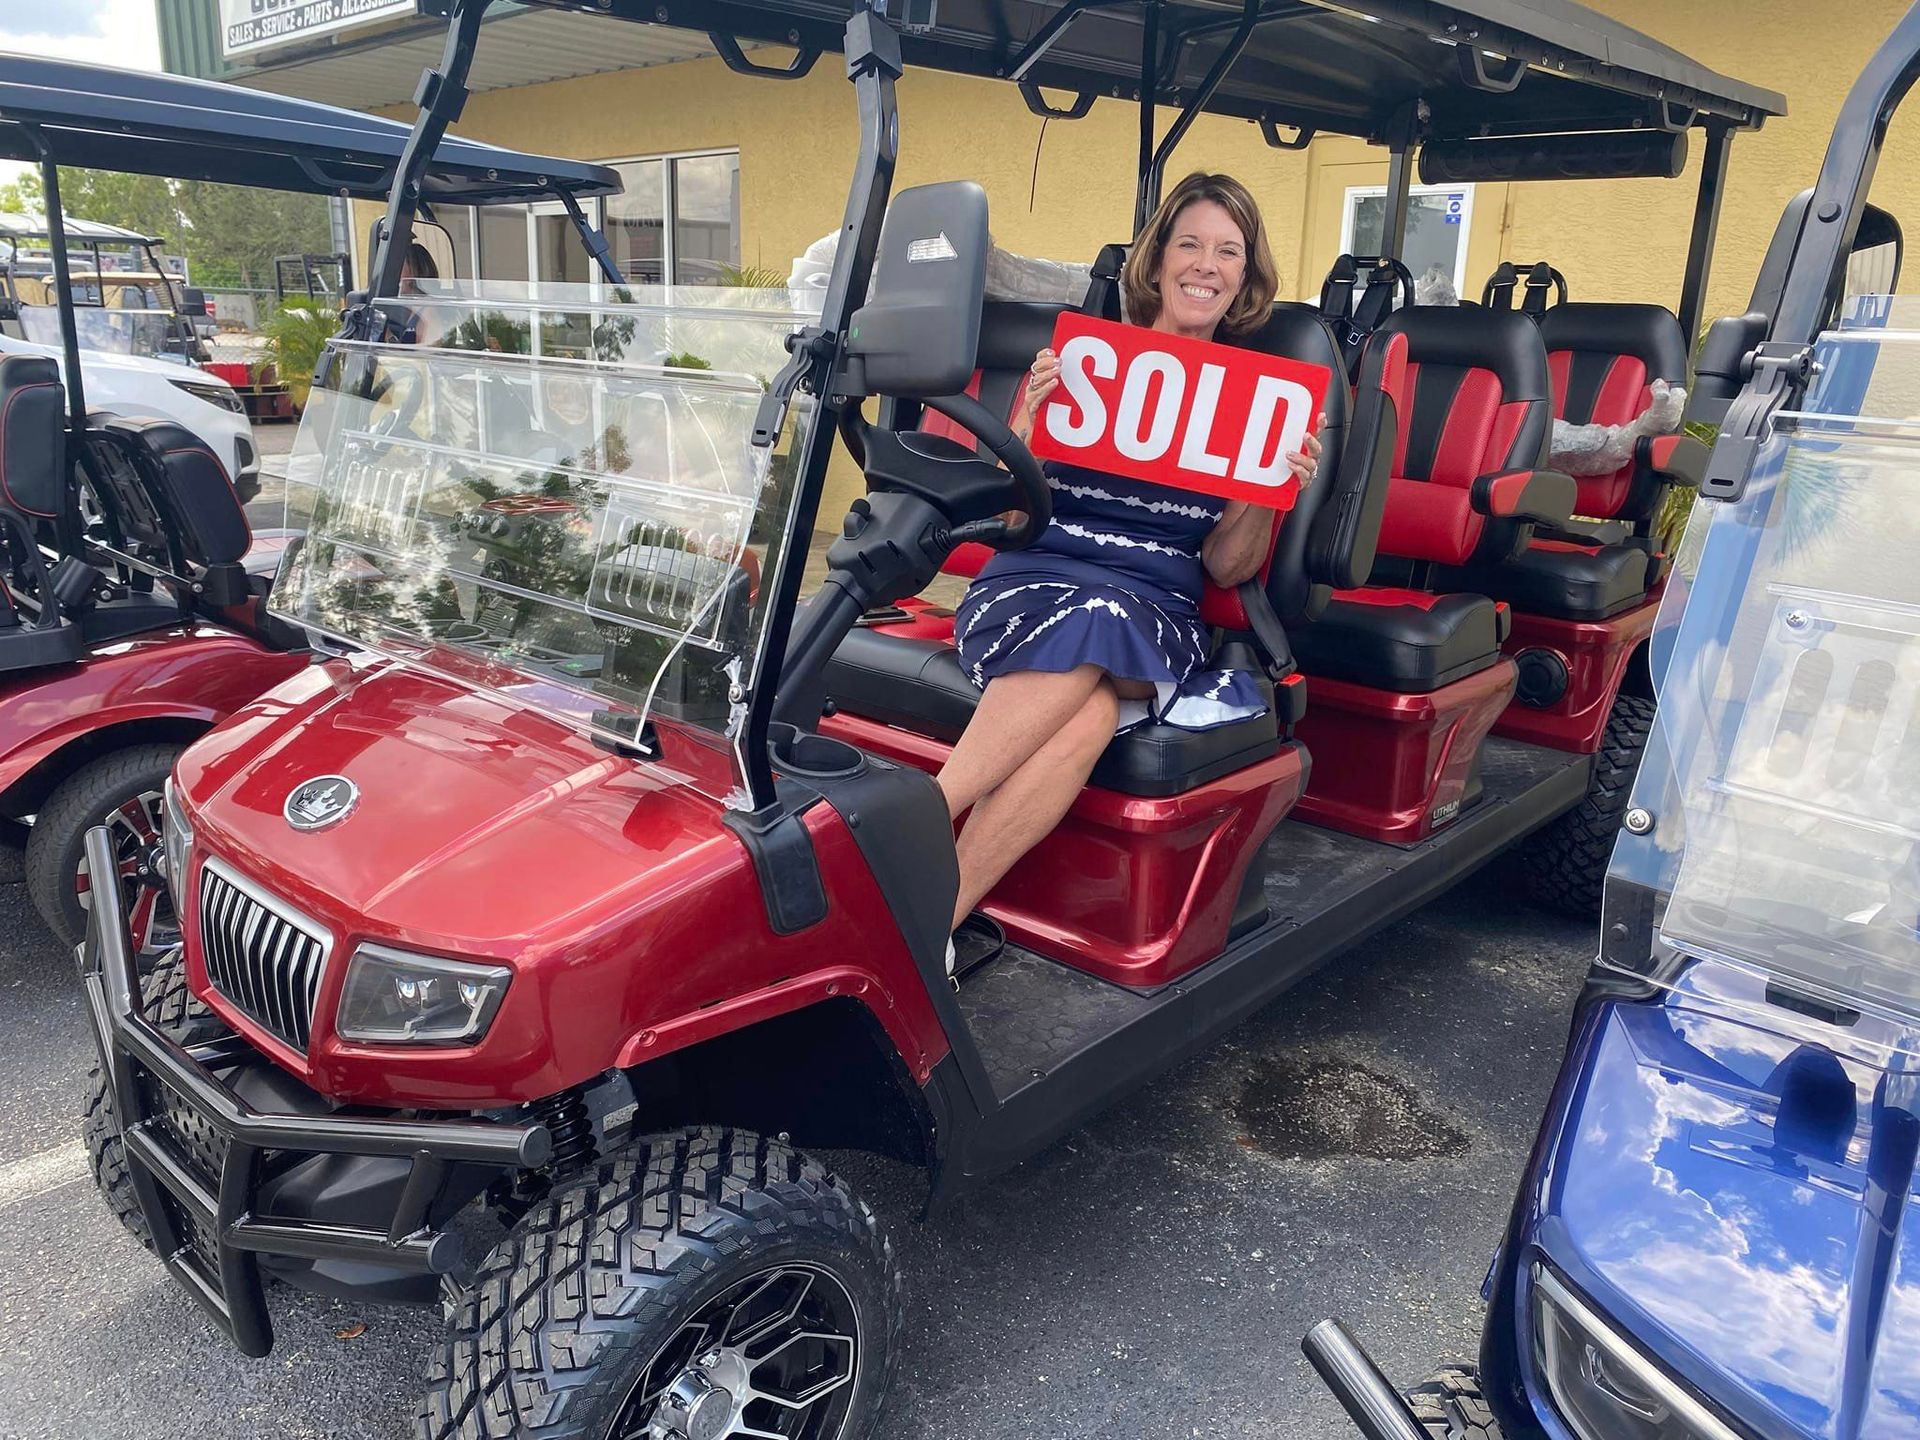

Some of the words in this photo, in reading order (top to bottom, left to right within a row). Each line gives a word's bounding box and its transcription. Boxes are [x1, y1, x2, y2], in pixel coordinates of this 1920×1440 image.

[229, 22, 254, 46] SALES
[261, 10, 296, 38] SERVICE
[303, 0, 332, 27] PARTS
[341, 0, 400, 17] ACCESS
[1046, 336, 1313, 487] SOLD
[1433, 799, 1460, 819] LITHIUM
